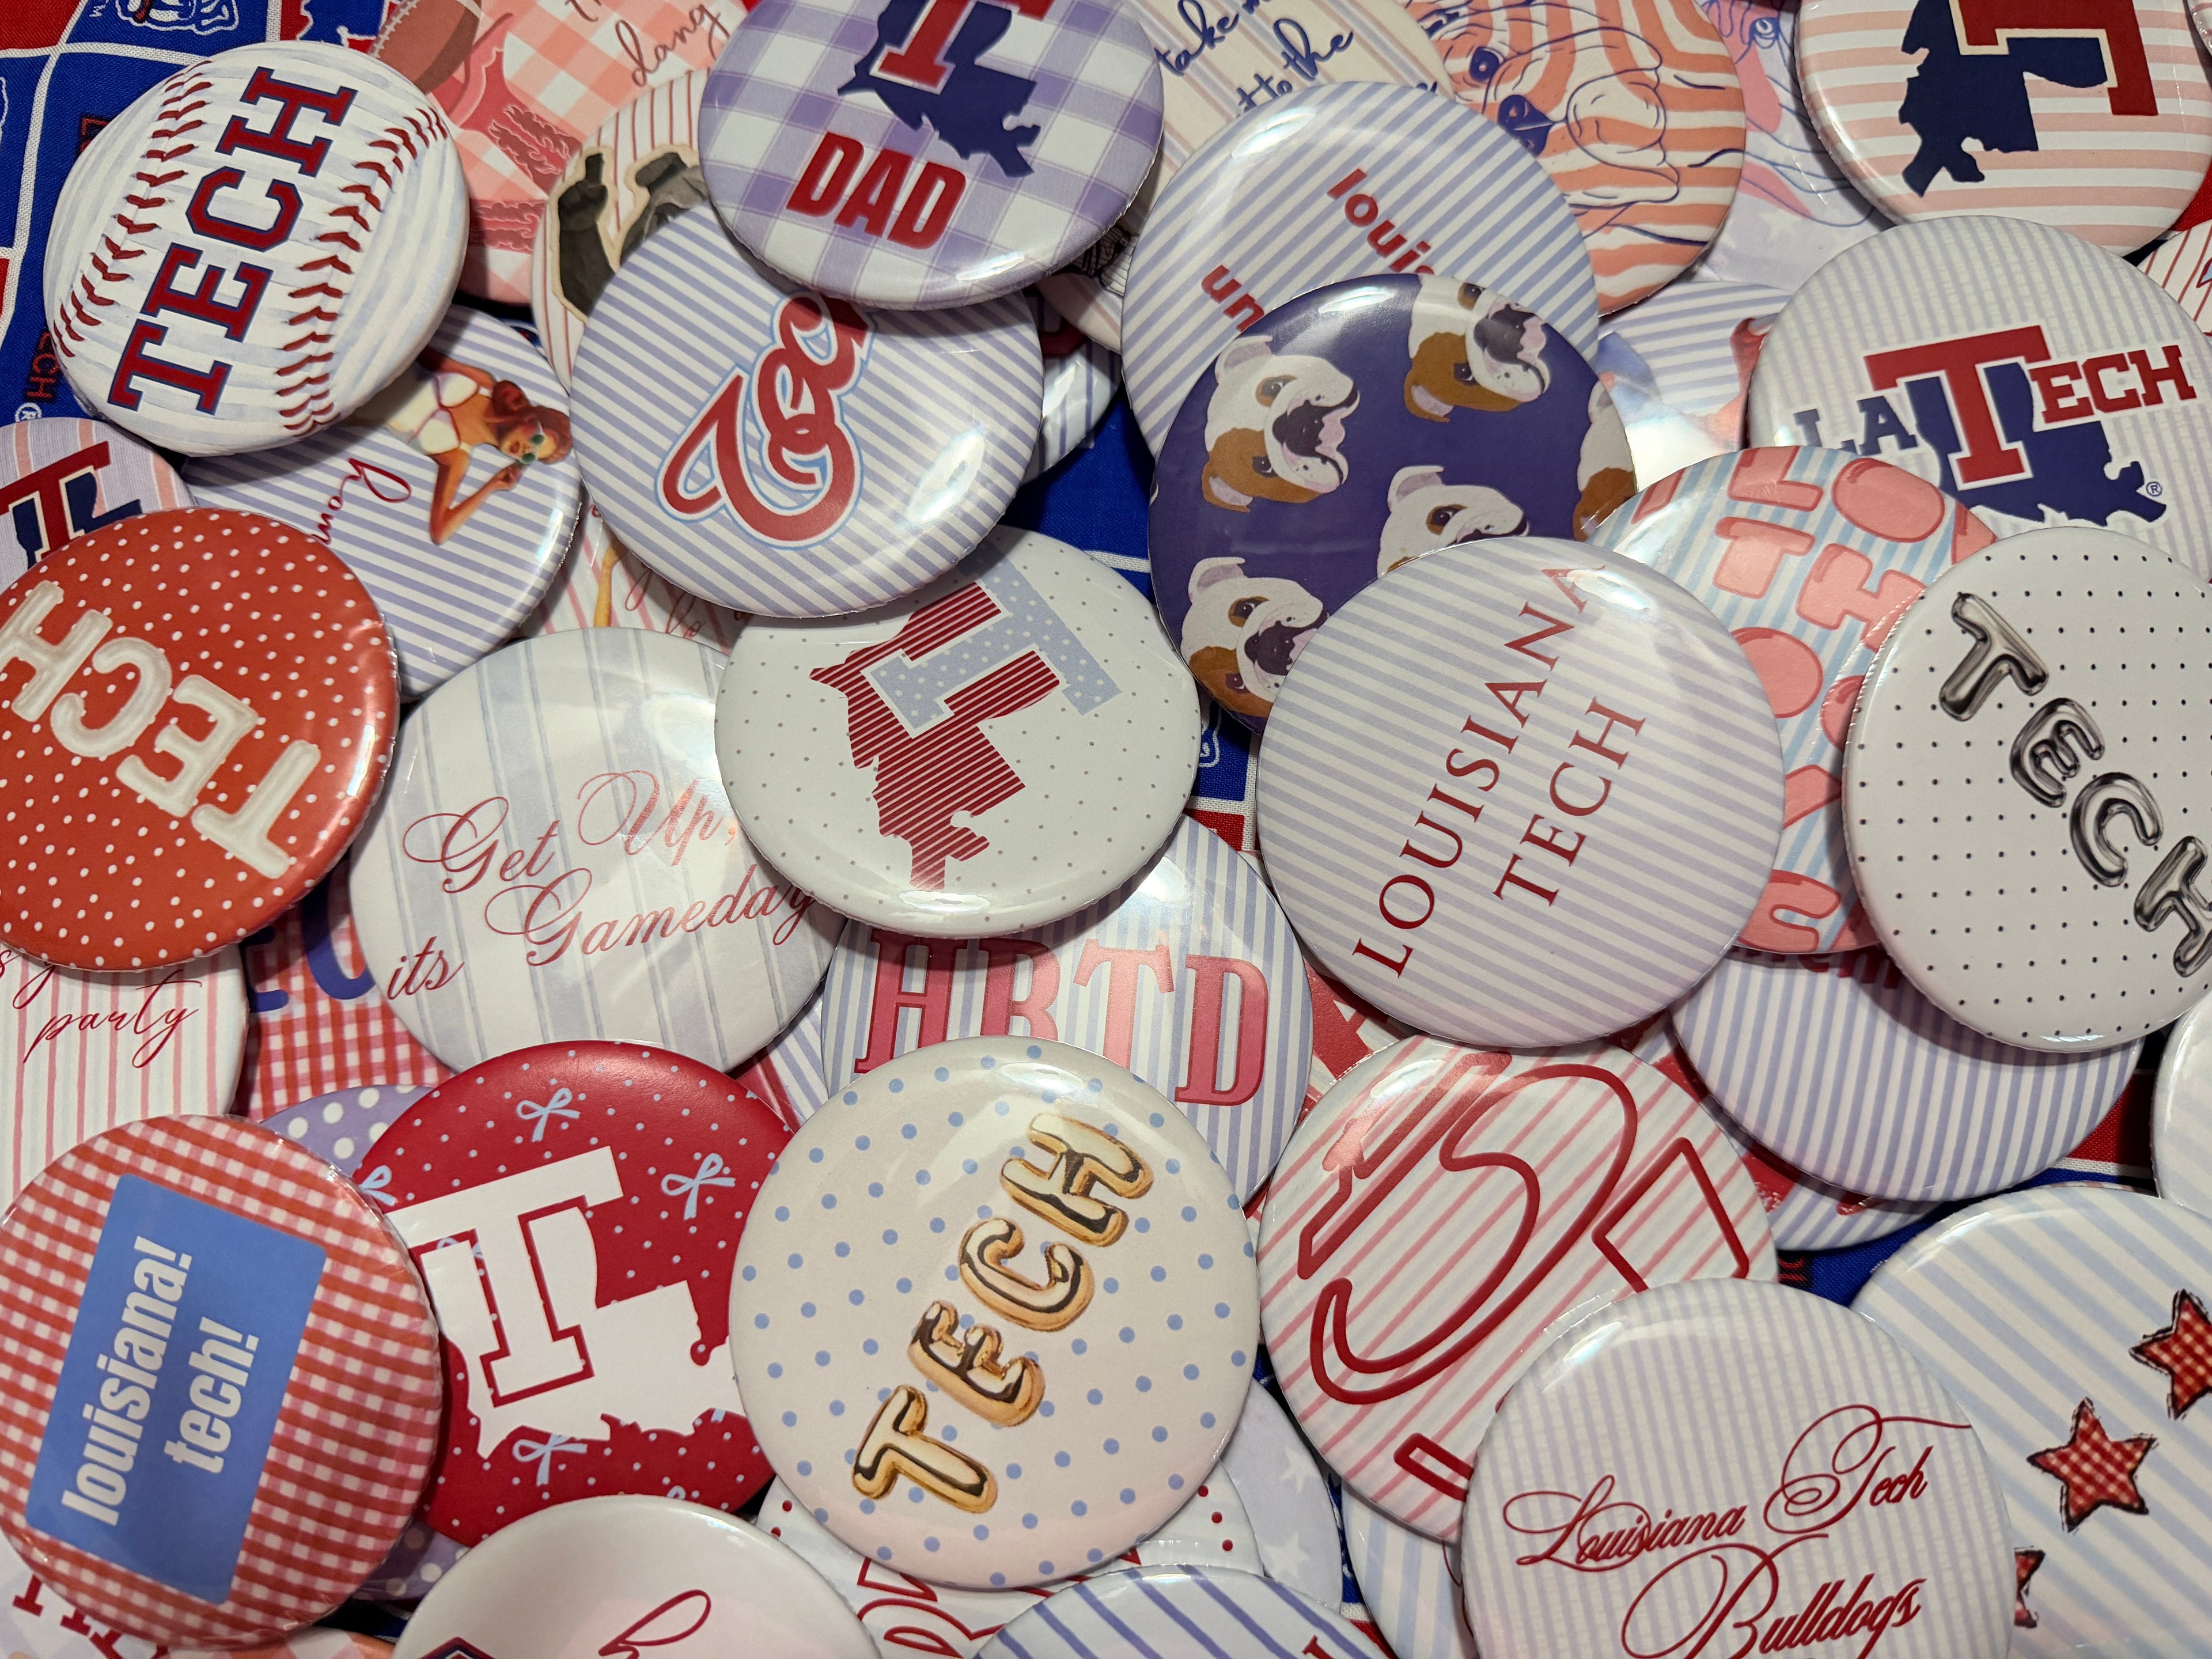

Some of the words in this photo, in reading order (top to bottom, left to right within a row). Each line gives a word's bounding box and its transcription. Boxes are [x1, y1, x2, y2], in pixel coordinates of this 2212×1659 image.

[1273, 18, 1353, 81] the
[107, 66, 359, 416] TECH
[786, 131, 967, 251] DAD
[1327, 168, 1435, 275] loui
[0, 580, 323, 880] TECH
[1351, 565, 1607, 979] LOUISIANA
[1491, 695, 1647, 908] TECH
[1939, 591, 2212, 978] TECH
[403, 796, 561, 894] Get
[388, 935, 465, 1001] its
[484, 863, 818, 968] Gameday
[23, 968, 203, 1069] party
[60, 1234, 193, 1528] louisiana!
[163, 1315, 260, 1475] tech!
[850, 1112, 1155, 1514] TECH
[1503, 1475, 1749, 1573] Louisiana
[1763, 1404, 1974, 1535] Tech
[1620, 1533, 1927, 1659] Bulldogs
